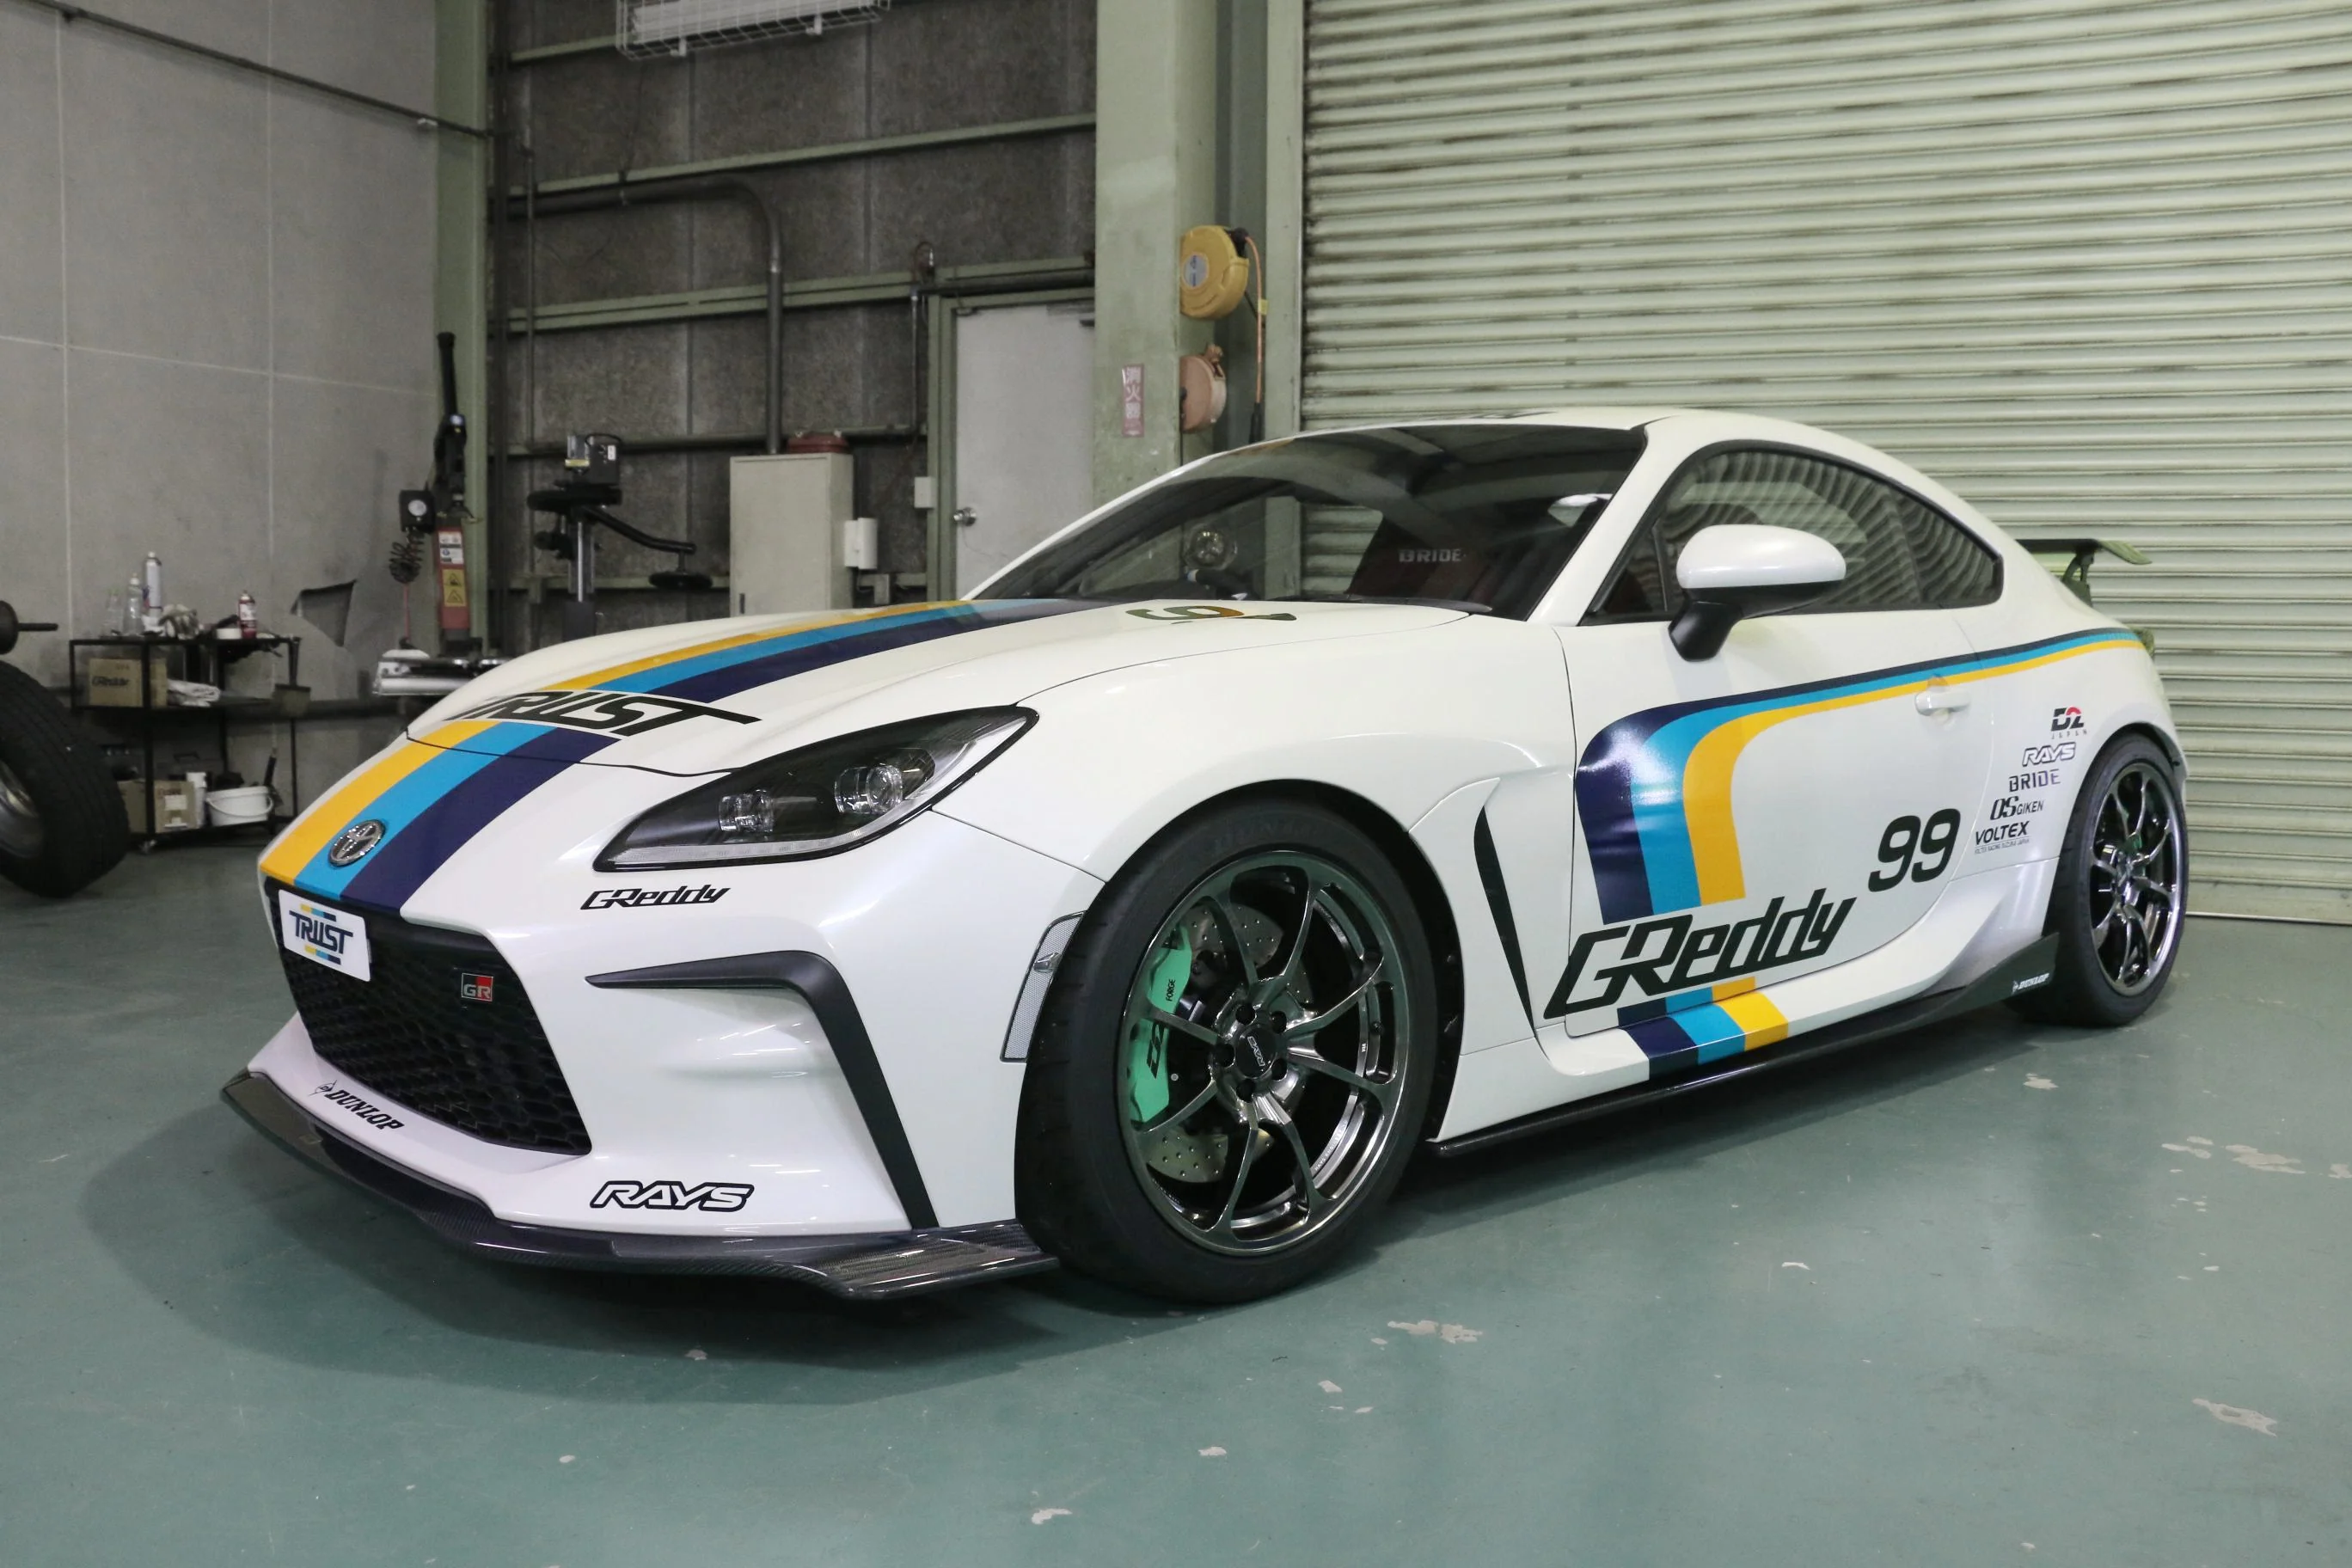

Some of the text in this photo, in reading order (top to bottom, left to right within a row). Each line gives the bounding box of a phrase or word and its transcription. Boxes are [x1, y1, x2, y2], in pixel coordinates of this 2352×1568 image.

[1399, 548, 1462, 562] BRIDE
[2051, 707, 2084, 732] D2
[2022, 742, 2076, 767] RAYS
[2009, 769, 2061, 792] BRIDE
[1990, 795, 2043, 820] OS GIKEN
[1975, 821, 2030, 845] VOLTEX
[1868, 808, 1961, 892] 99
[580, 885, 731, 910] GReddy
[289, 910, 353, 954] TRUST
[1543, 887, 1857, 1020] GReddy
[463, 983, 491, 999] GR
[1166, 979, 1176, 1001] FORGE
[1247, 1036, 1265, 1066] RAYS
[324, 1089, 405, 1130] DUNLOP
[590, 1180, 755, 1213] RAYS
